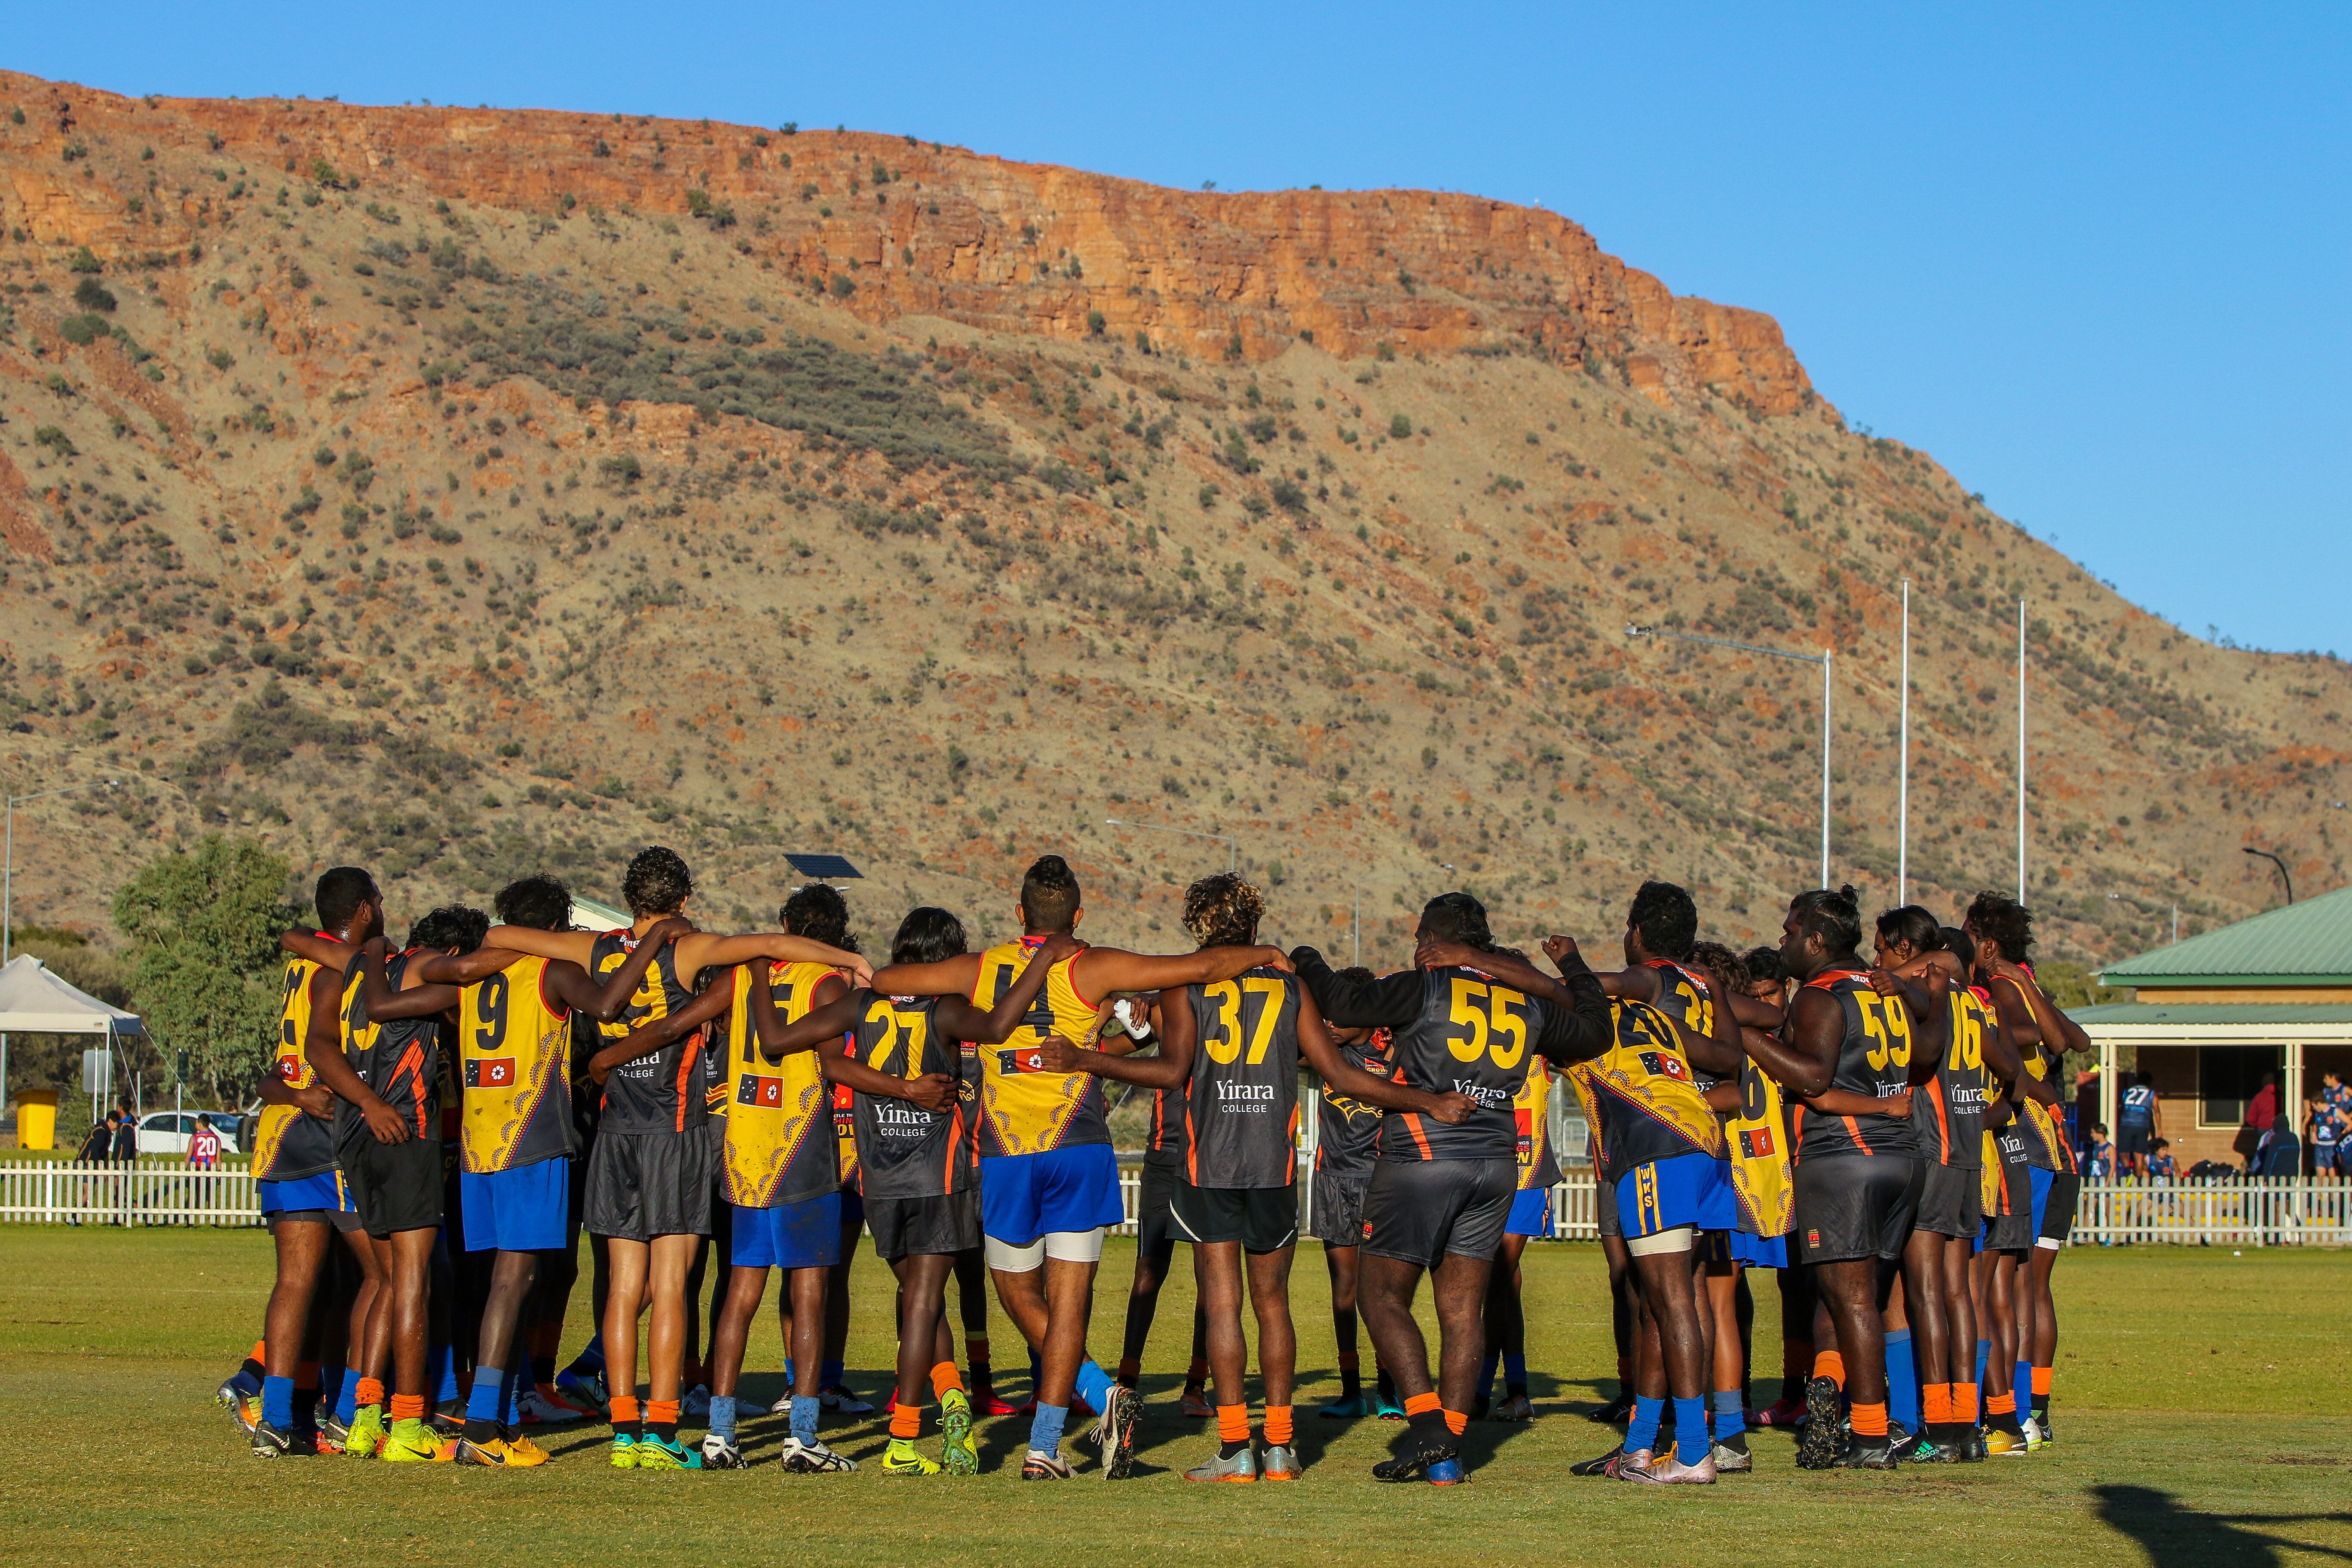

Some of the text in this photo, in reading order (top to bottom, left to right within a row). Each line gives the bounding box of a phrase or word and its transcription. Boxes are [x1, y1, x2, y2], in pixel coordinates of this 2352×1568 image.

[475, 972, 509, 1050] 9
[1204, 977, 1285, 1065] 37
[1447, 977, 1526, 1069] 55
[1852, 990, 1911, 1072] 59
[1949, 991, 1981, 1071] 16
[865, 1000, 926, 1081] 27
[617, 1069, 654, 1078] OLLEGE
[1216, 1079, 1275, 1099] Yirara
[2125, 1087, 2149, 1105] 27
[875, 1103, 933, 1124] Yirara
[1222, 1104, 1267, 1113] COLLEGE
[1954, 1106, 1981, 1114] COLLEGE
[881, 1128, 926, 1136] COLLEGE
[197, 1136, 216, 1156] 20
[1914, 1448, 1940, 1462] adidas
